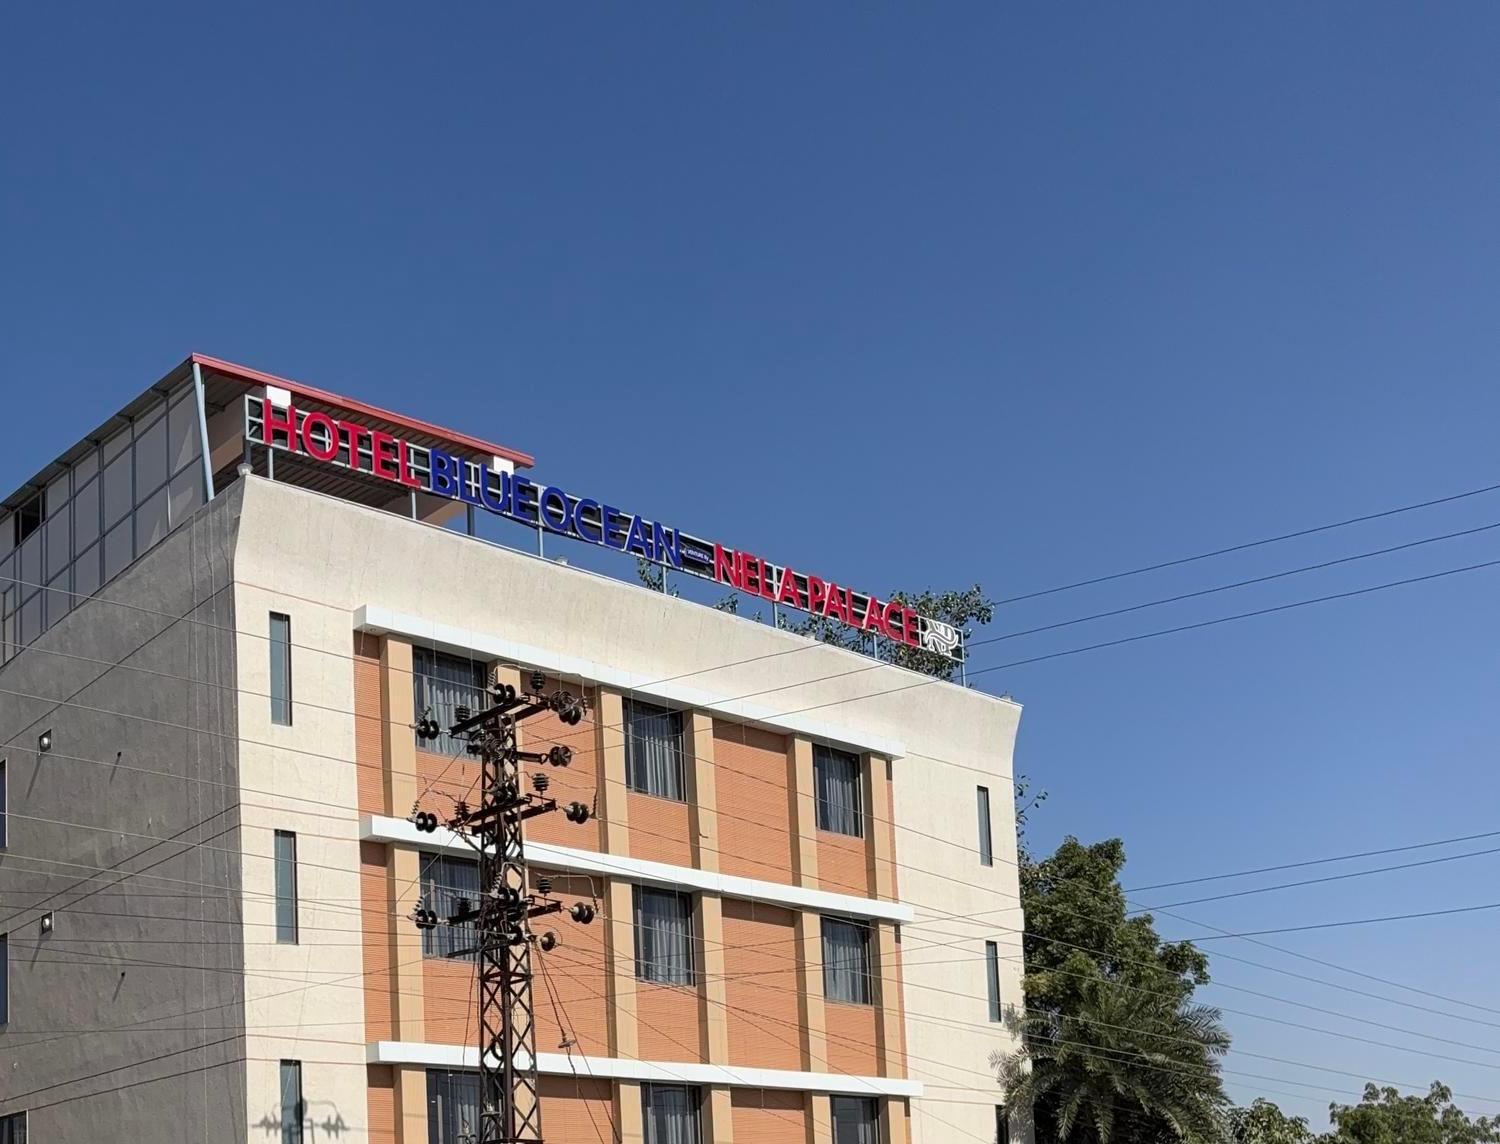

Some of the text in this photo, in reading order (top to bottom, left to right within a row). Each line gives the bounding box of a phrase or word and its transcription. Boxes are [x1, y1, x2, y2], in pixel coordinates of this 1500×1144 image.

[261, 398, 683, 569] HOTEL BLUE OCEAN
[713, 543, 920, 647] NELA PALACE
